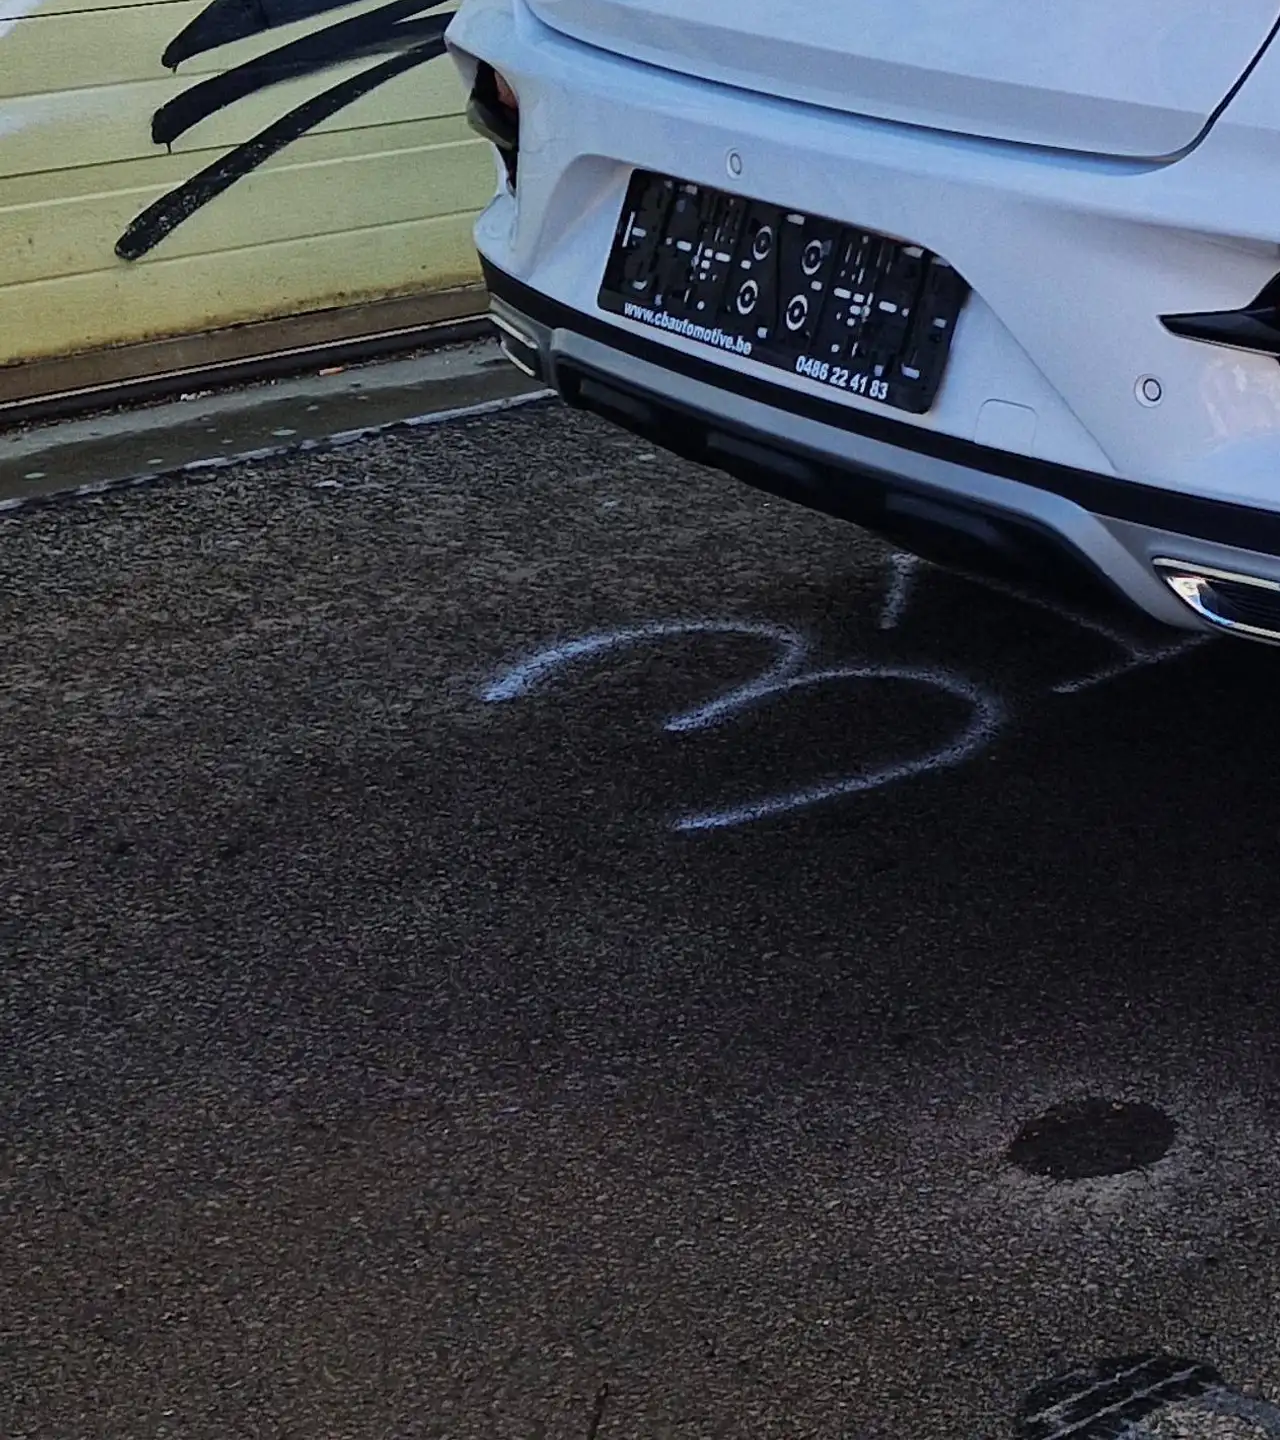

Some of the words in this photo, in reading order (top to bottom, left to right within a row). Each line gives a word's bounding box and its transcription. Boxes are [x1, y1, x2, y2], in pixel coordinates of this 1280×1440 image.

[624, 302, 752, 356] www.cbautomotive.be
[796, 355, 830, 381] 0486
[830, 366, 849, 387] 22
[850, 373, 869, 394] 41
[869, 379, 889, 400] 83
